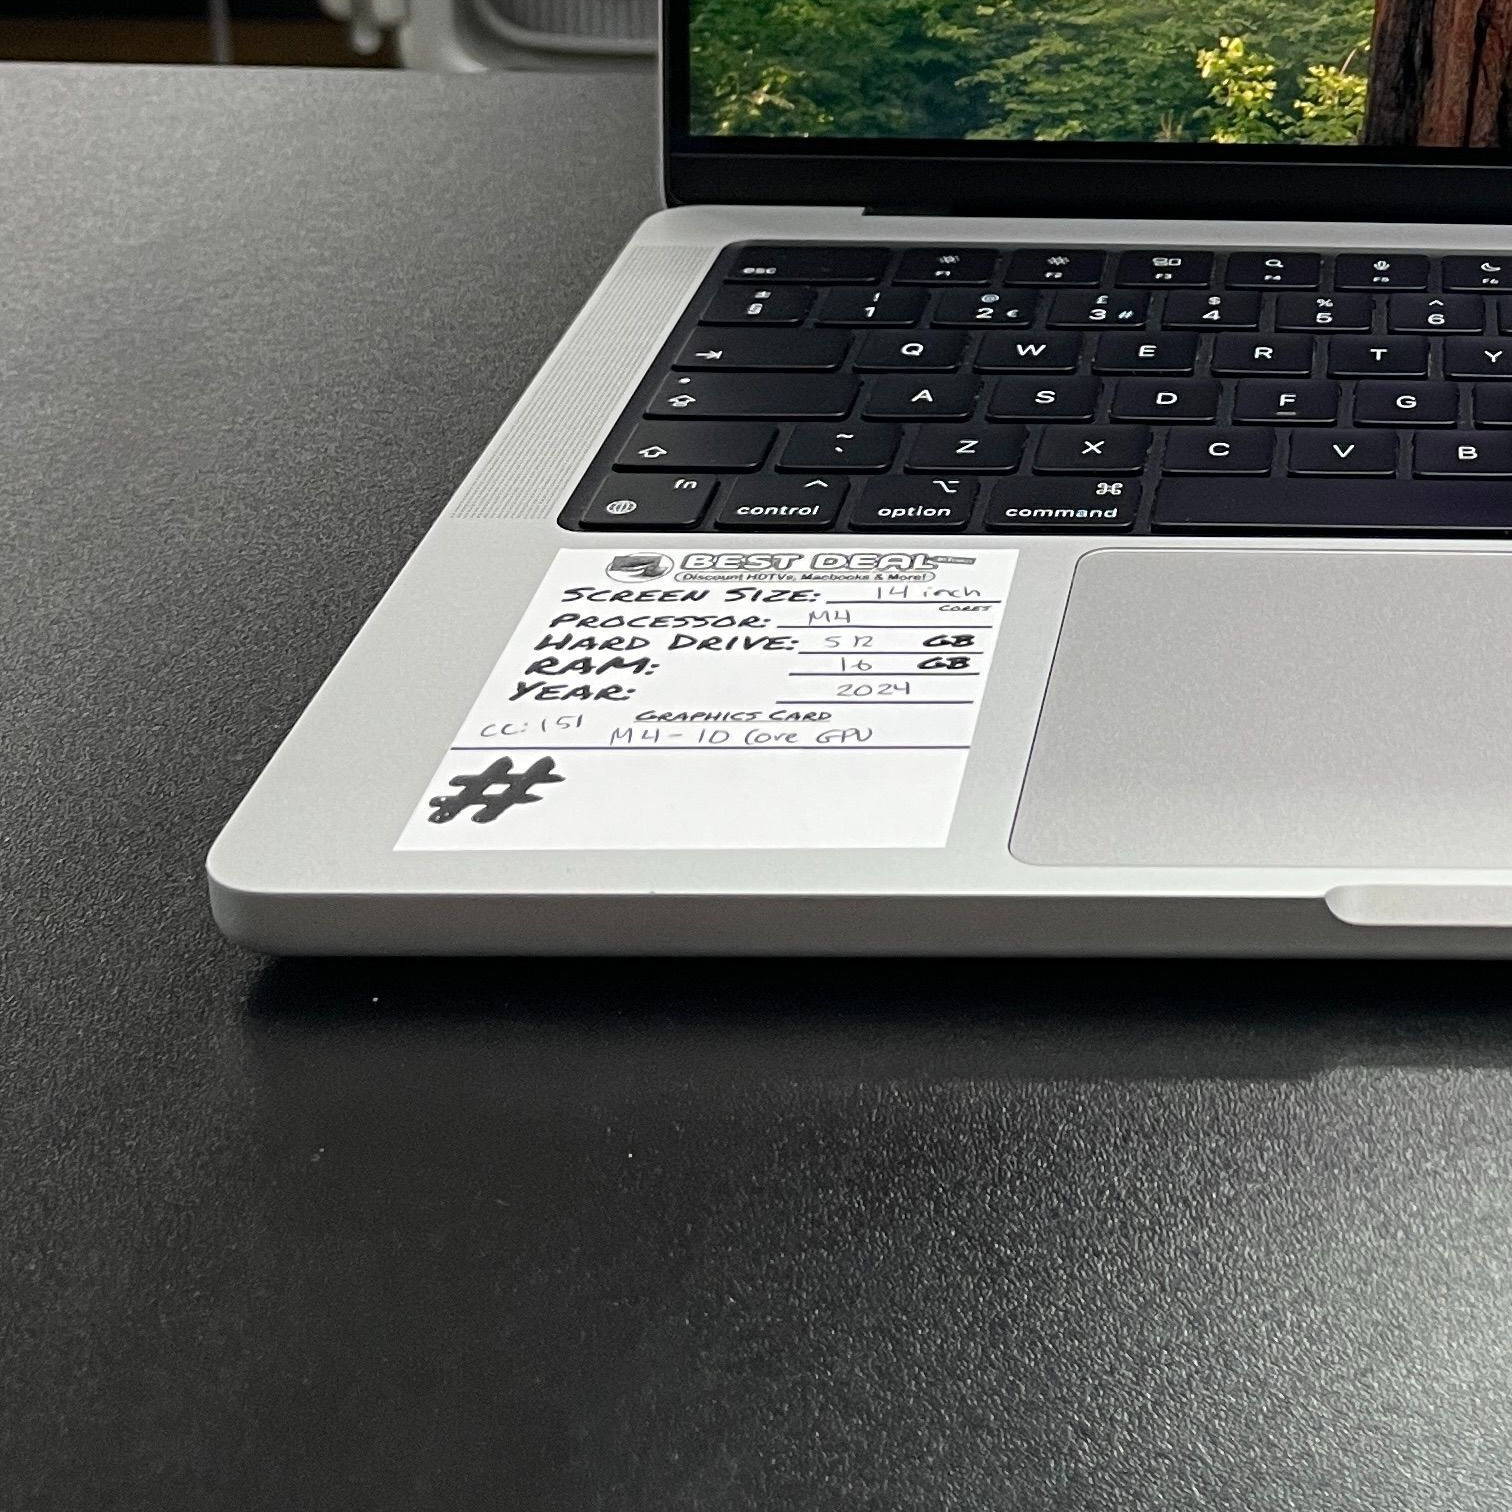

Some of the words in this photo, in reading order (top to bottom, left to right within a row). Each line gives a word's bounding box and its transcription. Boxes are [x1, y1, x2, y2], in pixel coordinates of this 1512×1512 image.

[864, 306, 876, 318] 1
[975, 307, 994, 319] 2
[1088, 308, 1107, 321] 3
[1202, 309, 1221, 321] 4
[1315, 312, 1333, 324] 5
[1427, 313, 1446, 325] 6
[901, 342, 924, 356] Q
[1016, 344, 1047, 356] W
[1138, 344, 1157, 357] E
[1254, 346, 1274, 359] R
[1369, 348, 1388, 361] T
[1484, 350, 1503, 363] Y
[911, 389, 933, 402] A
[1034, 390, 1056, 404] S
[1155, 392, 1178, 405] D
[1279, 393, 1297, 407] F
[1396, 395, 1417, 409] G
[955, 439, 979, 454] Z
[1081, 440, 1105, 455] X
[1208, 442, 1230, 457] C
[1332, 444, 1355, 458] V
[1458, 445, 1478, 460] B
[673, 478, 698, 489] fn
[736, 505, 820, 516] control
[877, 505, 951, 519] option
[1005, 507, 1118, 518] command
[680, 553, 804, 571] BEST
[811, 553, 938, 571] DEAL
[683, 572, 743, 581] Discount
[801, 573, 870, 581] Macbooks
[874, 573, 884, 581] &
[887, 573, 926, 581] More!
[561, 587, 710, 602] SCREEN
[724, 587, 821, 602] SIZE:
[878, 585, 908, 599] 14
[923, 586, 981, 598] inch
[549, 613, 771, 628] PROCESSOR:
[809, 609, 850, 626] M4
[533, 633, 650, 651] HARD
[668, 633, 800, 651] DRIVE:
[923, 635, 975, 647] GB
[525, 656, 660, 675] RAM:
[840, 657, 872, 672] 16
[917, 656, 971, 669] GB
[508, 681, 636, 701] YEAR:
[836, 681, 911, 697] 2024
[634, 709, 763, 722] GRAPHICS
[769, 709, 832, 722] CARD
[744, 728, 798, 745] Core
[815, 727, 873, 745] GPU
[427, 755, 567, 824] #
